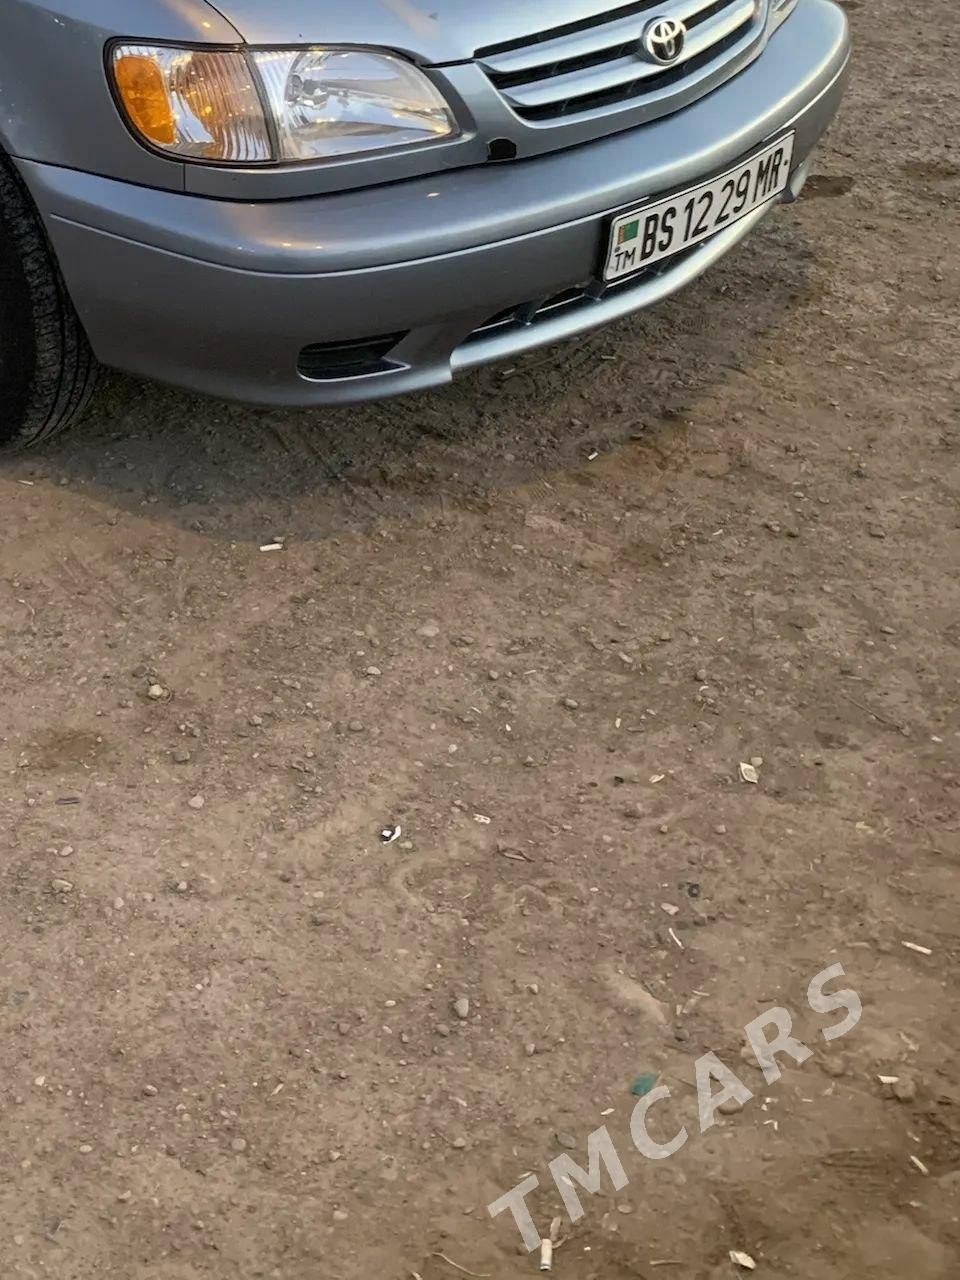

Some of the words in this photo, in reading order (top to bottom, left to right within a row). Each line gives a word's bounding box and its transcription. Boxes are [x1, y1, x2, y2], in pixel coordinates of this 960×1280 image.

[640, 207, 677, 261] BS
[752, 147, 785, 203] MR
[615, 247, 637, 272] TM
